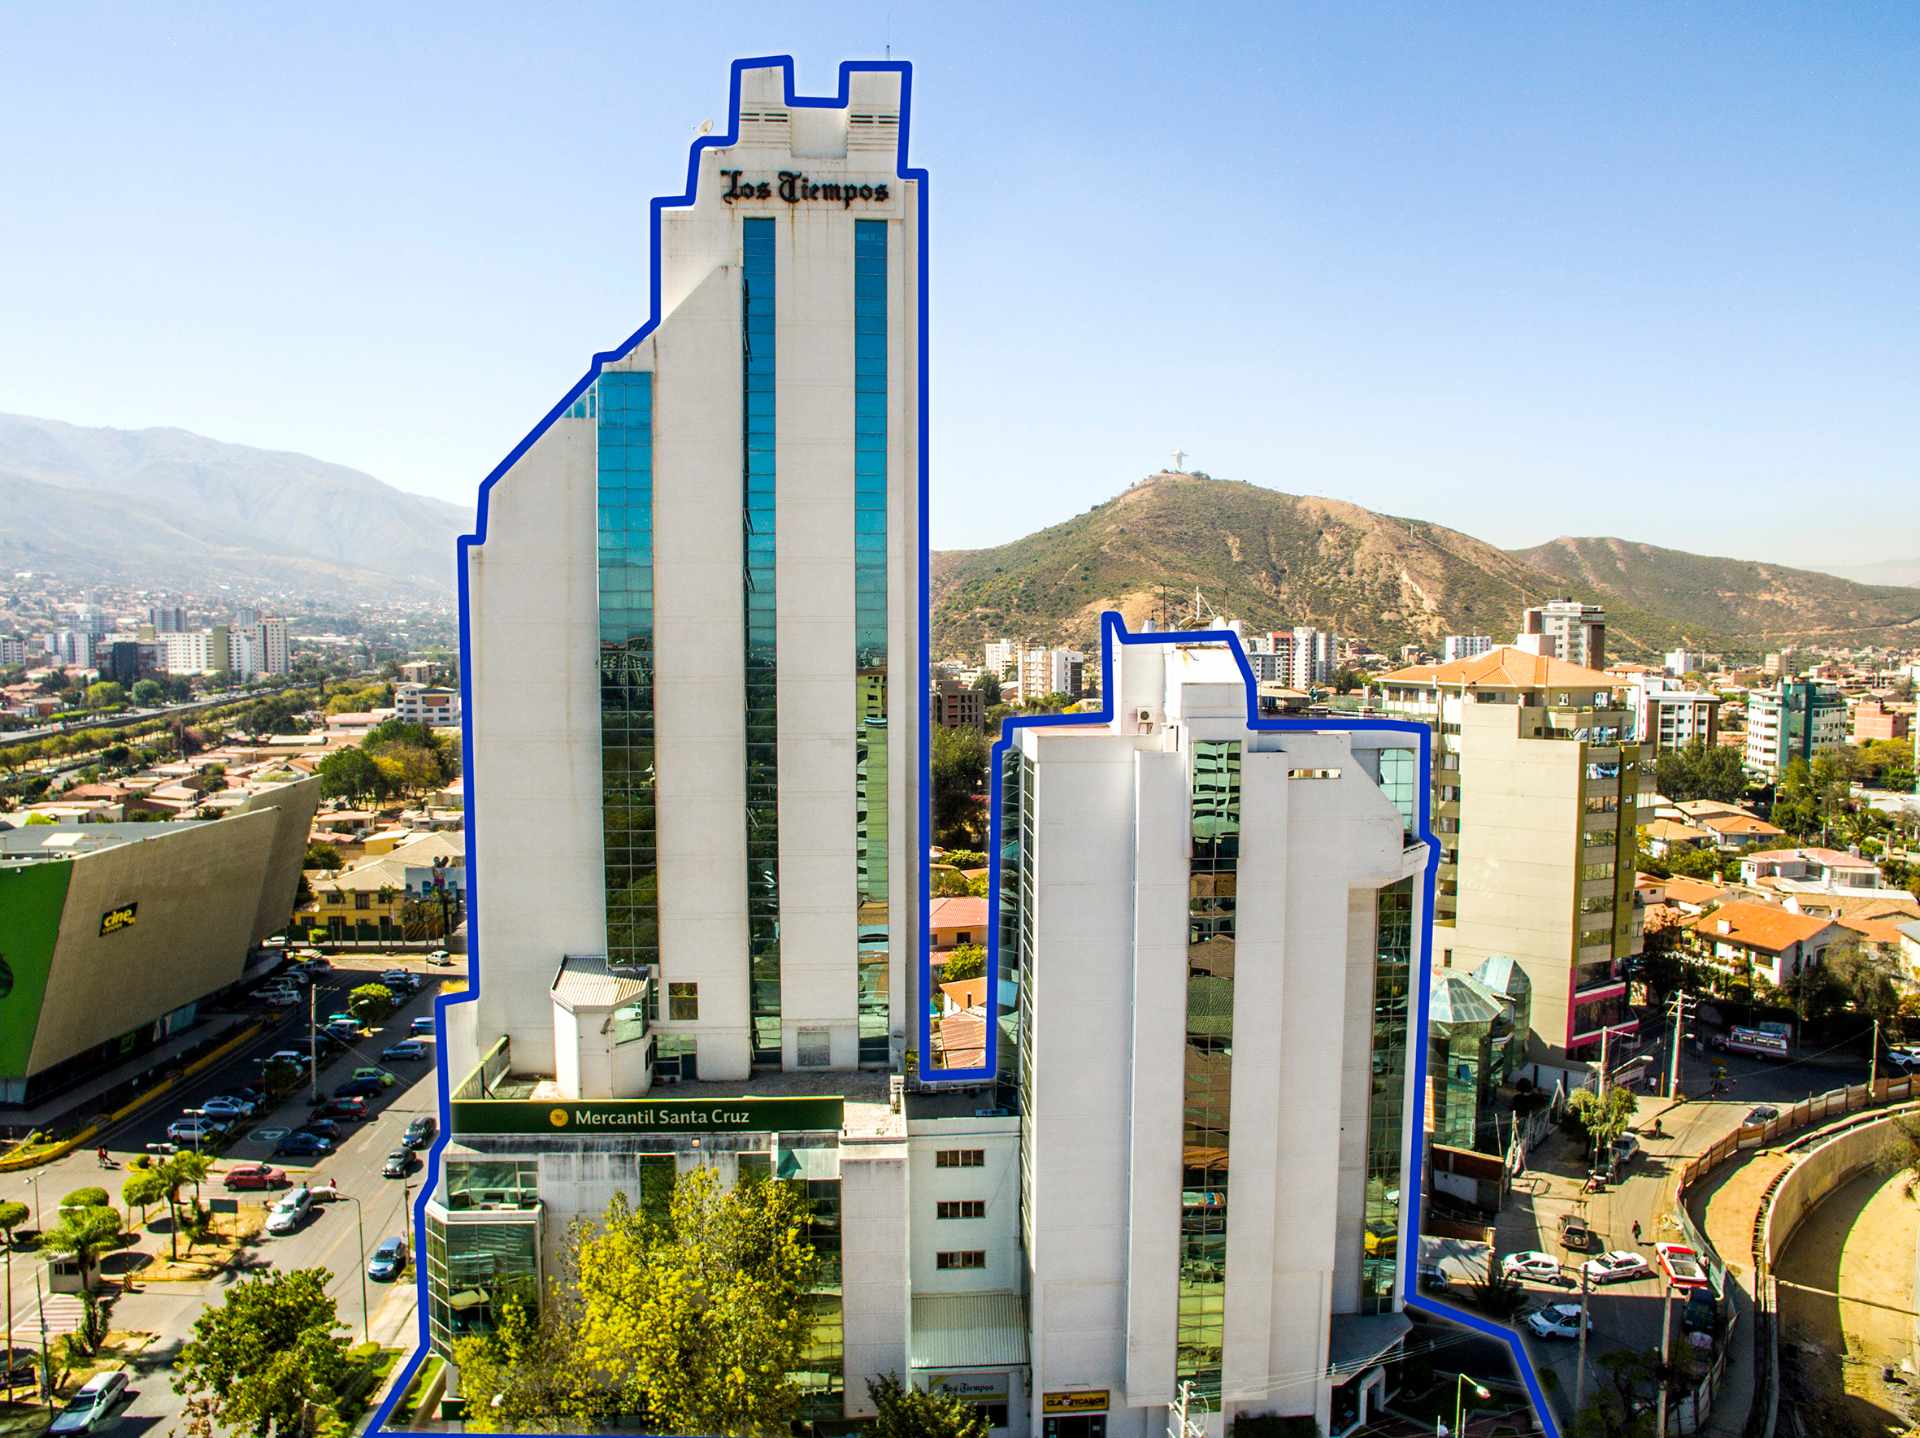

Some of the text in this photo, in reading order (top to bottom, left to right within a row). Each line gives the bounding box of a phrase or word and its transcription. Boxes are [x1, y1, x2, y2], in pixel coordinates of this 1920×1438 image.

[720, 169, 889, 210] Los Tiempos
[575, 1109, 749, 1125] Mercantil Santa Cruz
